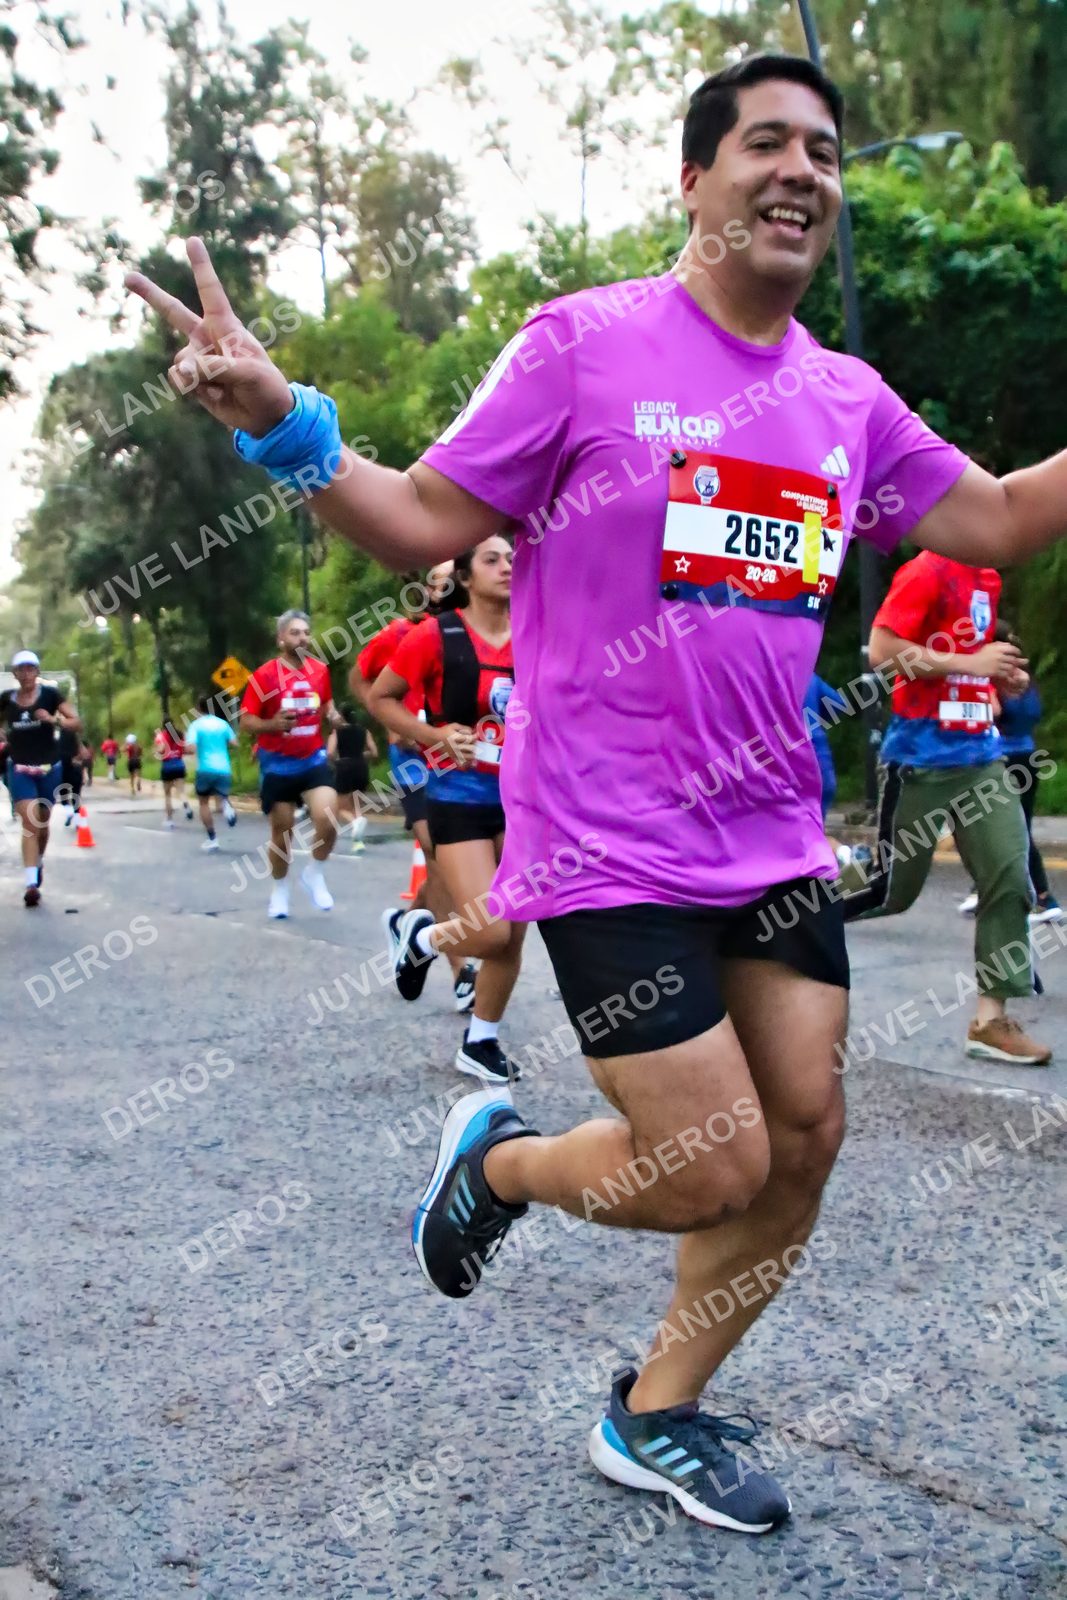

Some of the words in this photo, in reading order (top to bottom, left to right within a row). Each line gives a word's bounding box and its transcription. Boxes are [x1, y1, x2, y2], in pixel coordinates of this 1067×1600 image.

[634, 401, 677, 414] LEGACY
[635, 414, 681, 437] RUN
[724, 513, 799, 564] 2652
[807, 595, 822, 609] 5K
